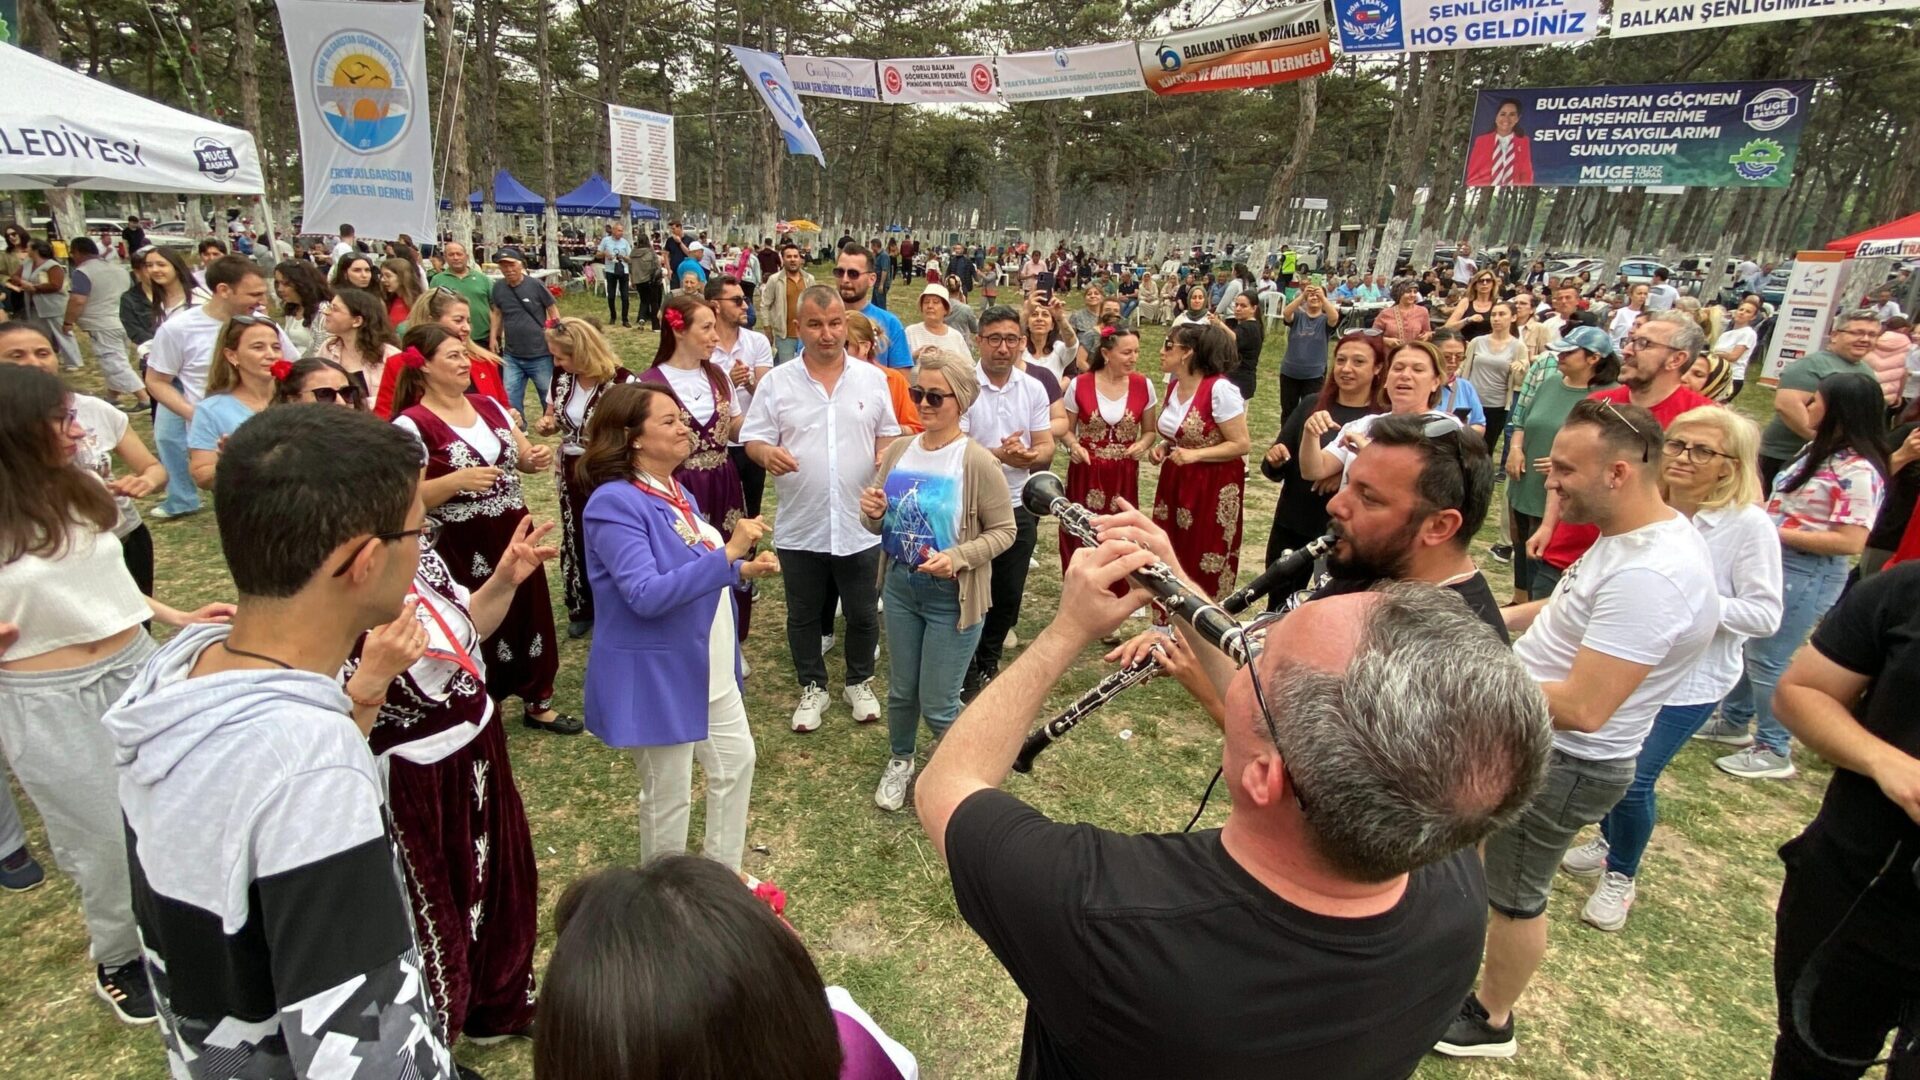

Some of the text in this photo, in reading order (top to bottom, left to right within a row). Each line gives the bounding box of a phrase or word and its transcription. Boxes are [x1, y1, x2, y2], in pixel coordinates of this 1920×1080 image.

[1619, 4, 1694, 28] BALKAN
[1410, 9, 1587, 46] HOŞ GELDİNİZ
[1183, 19, 1321, 59] BALKAN TÜRK AYDINLARI
[1198, 68, 1211, 82] VE
[1210, 60, 1270, 81] DAYANIŞMA
[1270, 47, 1326, 74] DERNEĞİ
[941, 71, 966, 80] DERNEĞİ
[792, 80, 811, 92] BALKAN
[842, 84, 853, 98] HOŞ
[1536, 90, 1742, 111] BULGARİSTAN GÖÇMENİ
[1558, 108, 1707, 126] HEMŞEHRİLERİME
[1534, 126, 1722, 141] SEVGİ VE SAYGILARIMI
[0, 124, 146, 167] LEDİYESİ
[1569, 143, 1678, 156] SUNUYORUM
